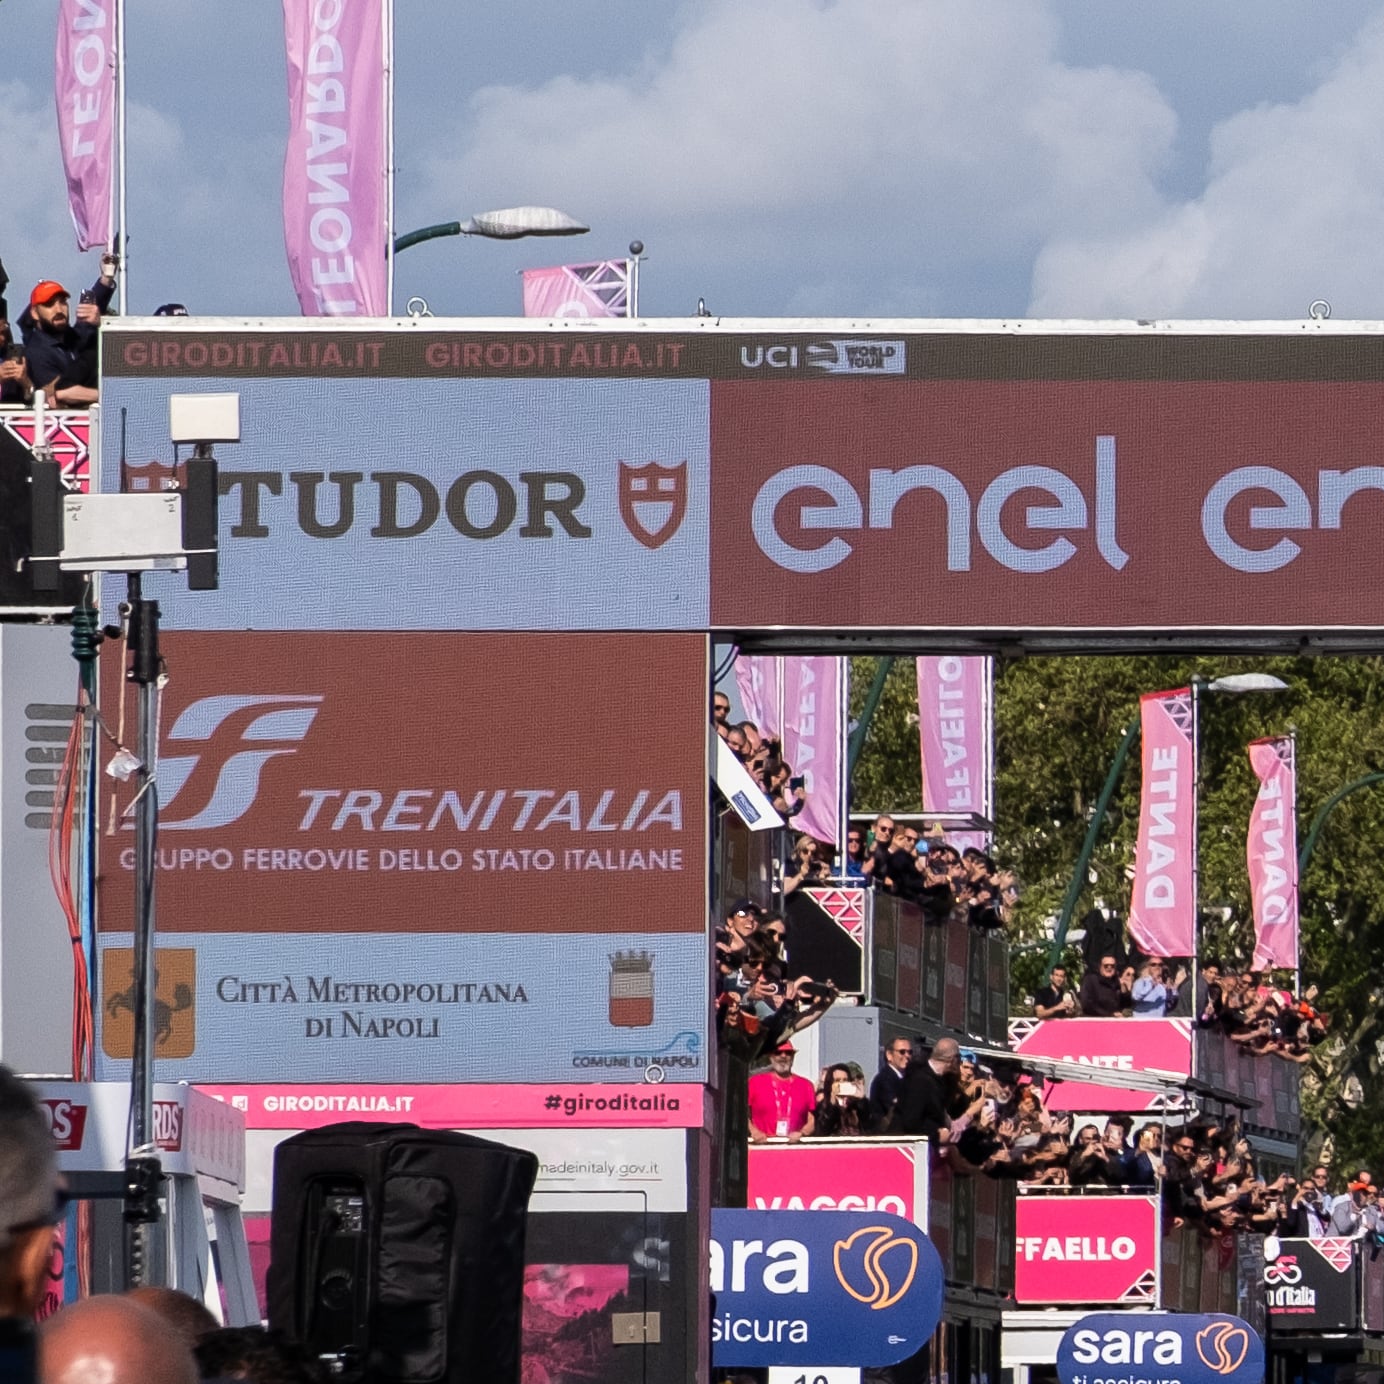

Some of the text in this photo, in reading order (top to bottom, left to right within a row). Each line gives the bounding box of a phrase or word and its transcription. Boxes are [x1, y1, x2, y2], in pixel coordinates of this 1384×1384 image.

[123, 341, 684, 370] GIRODITALIA.IT GIRODITALIA.IT
[740, 346, 797, 369] UCI
[845, 344, 896, 358] WORLD
[847, 357, 885, 370] TOUR
[214, 469, 592, 539] TUDOR
[752, 436, 1130, 573] enel
[297, 788, 684, 832] TRENITALIA
[119, 848, 684, 872] GUPPO FERROVIE DELLO STATO ITALIANE
[305, 976, 530, 1005] METROPOLITANA
[341, 1010, 441, 1040] NAPOLI
[572, 1055, 699, 1069] COMUNE DI NAPOLI
[262, 1094, 415, 1114] GIRODITALIA.IT
[544, 1092, 681, 1117] #giroditalia
[1072, 1329, 1183, 1365] sara
